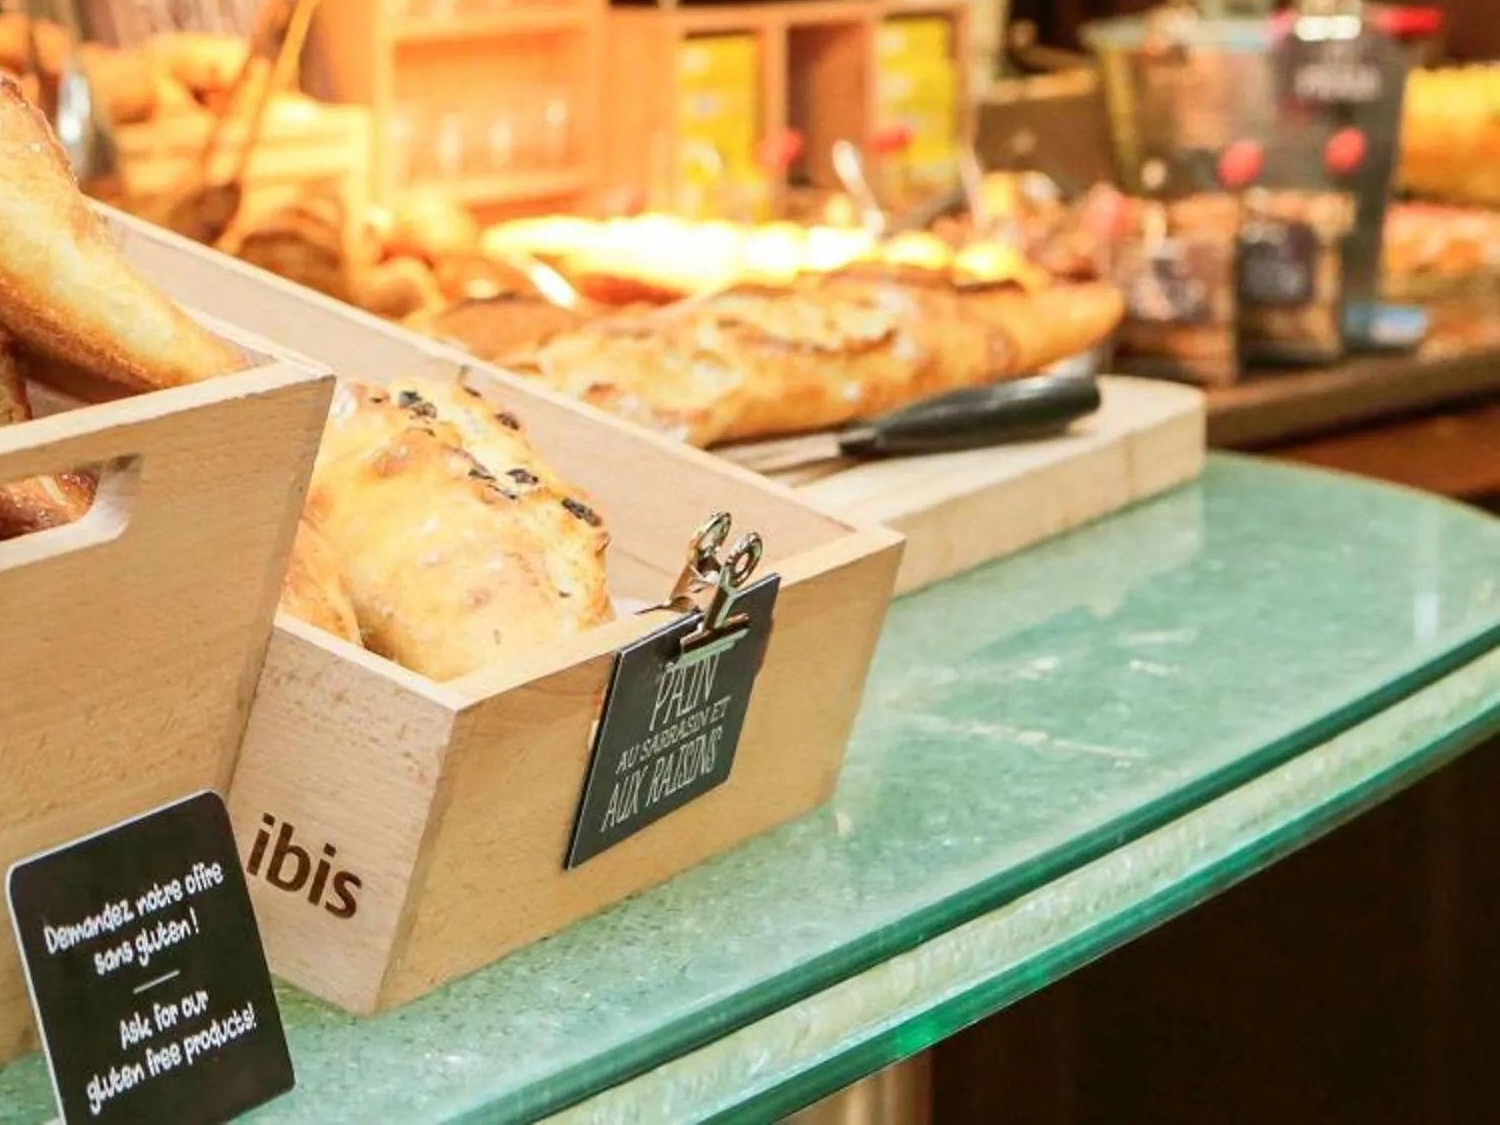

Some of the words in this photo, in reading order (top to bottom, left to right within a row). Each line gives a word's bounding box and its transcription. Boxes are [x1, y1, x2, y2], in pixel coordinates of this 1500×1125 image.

[616, 743, 640, 775] AU
[710, 695, 732, 723] ET
[649, 655, 719, 732] PAIN
[600, 765, 648, 833] AUX
[646, 726, 723, 807] RAISINS
[43, 899, 133, 955] Demandez
[136, 878, 183, 916] notre
[185, 862, 224, 895] offre
[247, 812, 362, 919] ibis
[94, 940, 133, 975] sans
[136, 919, 190, 967] gluten
[86, 1063, 146, 1116] gluten
[146, 1044, 182, 1079] free
[184, 1002, 258, 1065] products!
[119, 1013, 154, 1051] Ask
[153, 1002, 179, 1032] for
[181, 990, 210, 1019] our
